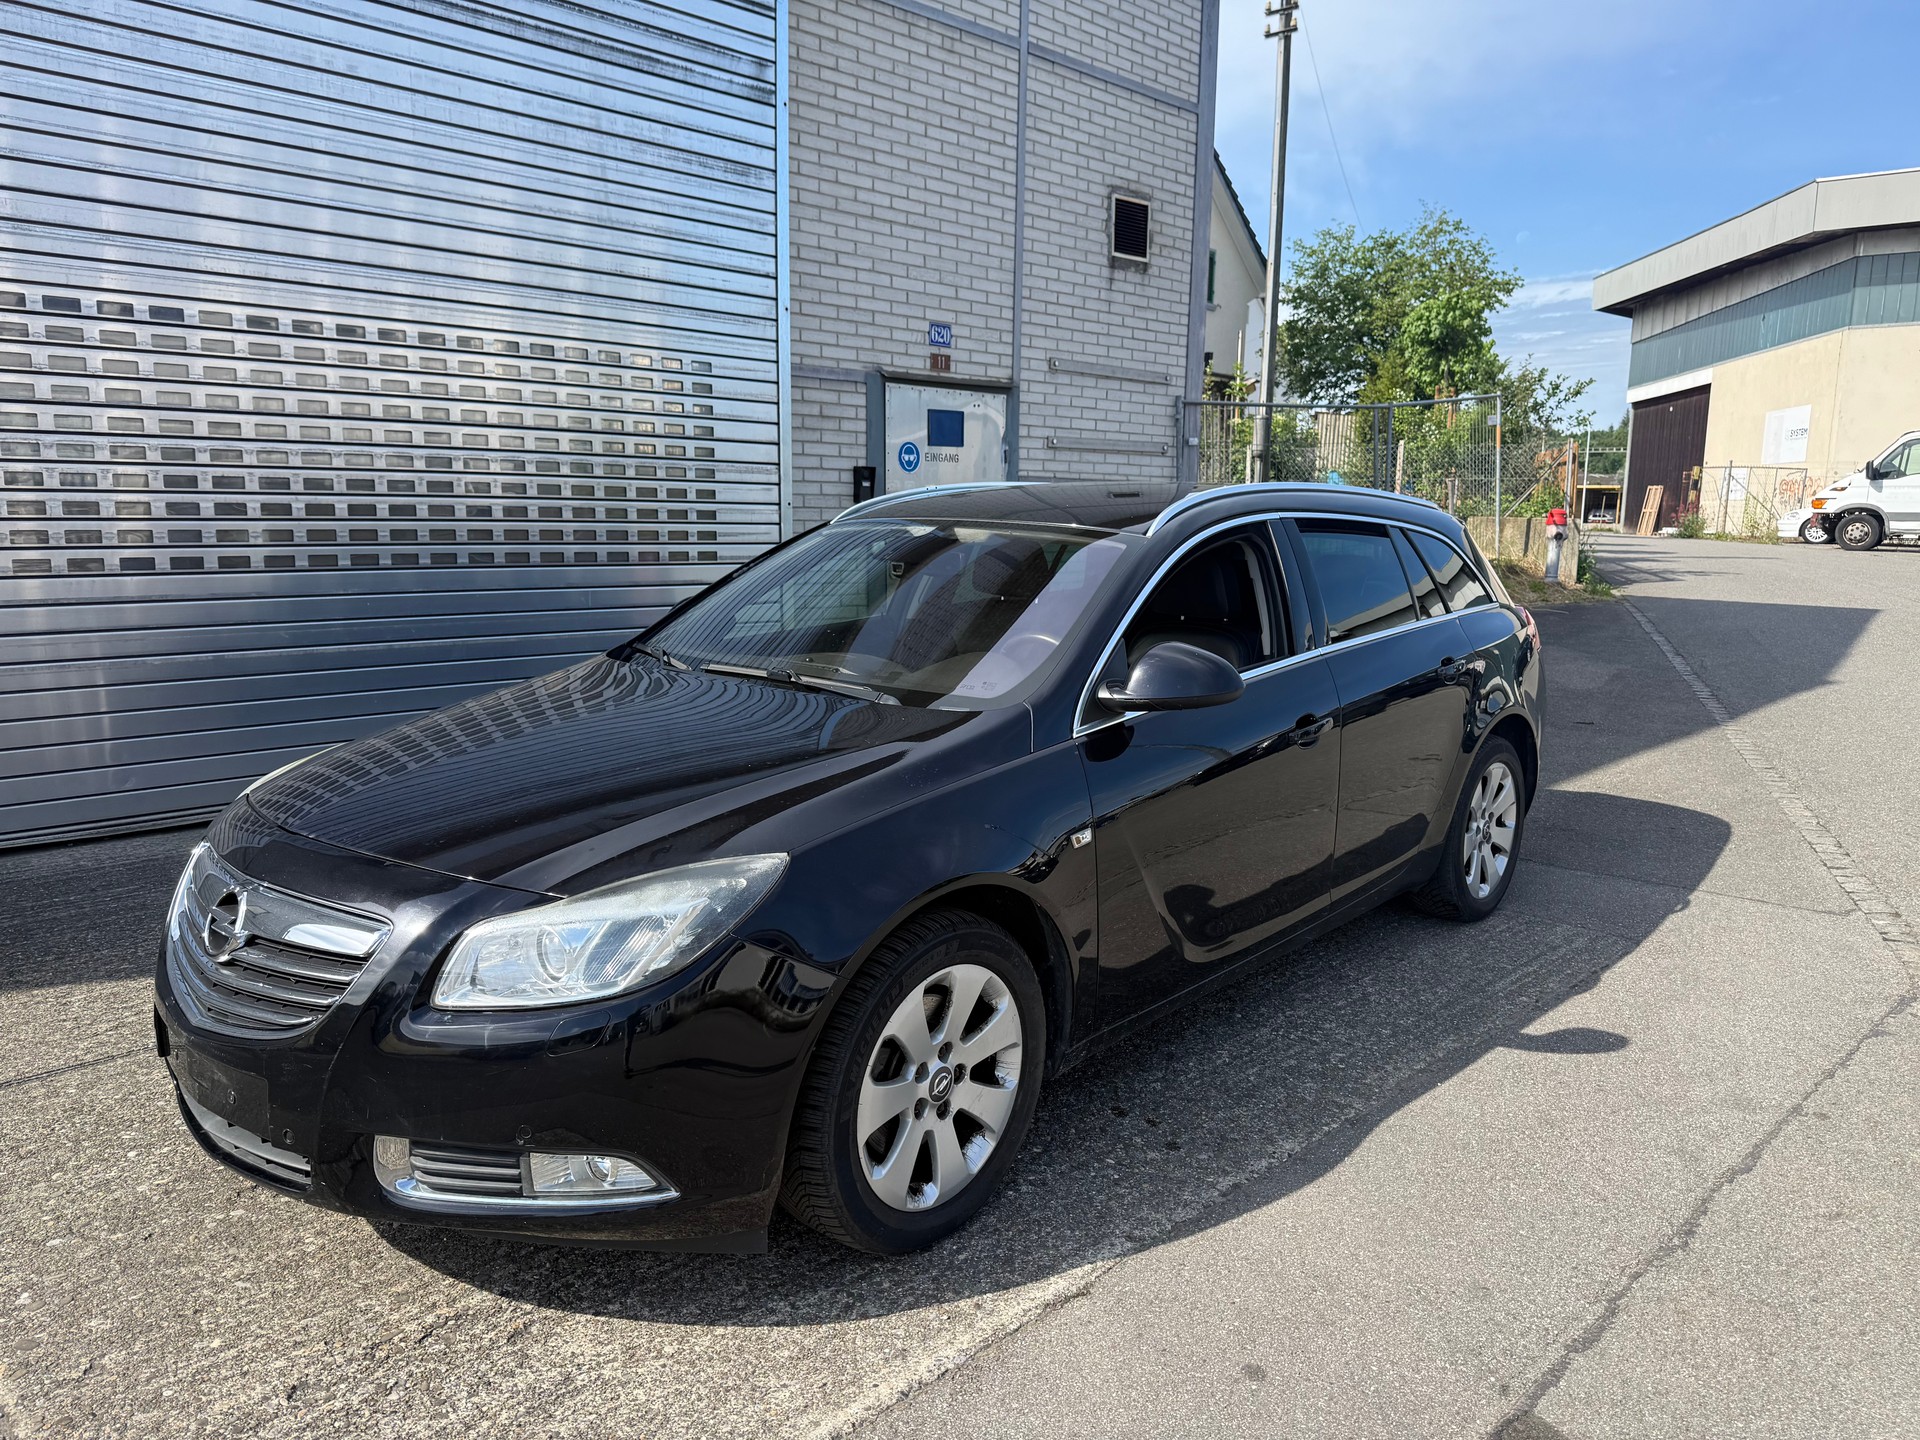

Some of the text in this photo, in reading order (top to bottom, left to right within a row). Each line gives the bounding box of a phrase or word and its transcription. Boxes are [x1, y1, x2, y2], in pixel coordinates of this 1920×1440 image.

[931, 325, 951, 344] 620
[937, 355, 946, 369] 11
[1789, 427, 1809, 438] SYSTEM
[925, 452, 960, 464] EINGANG
